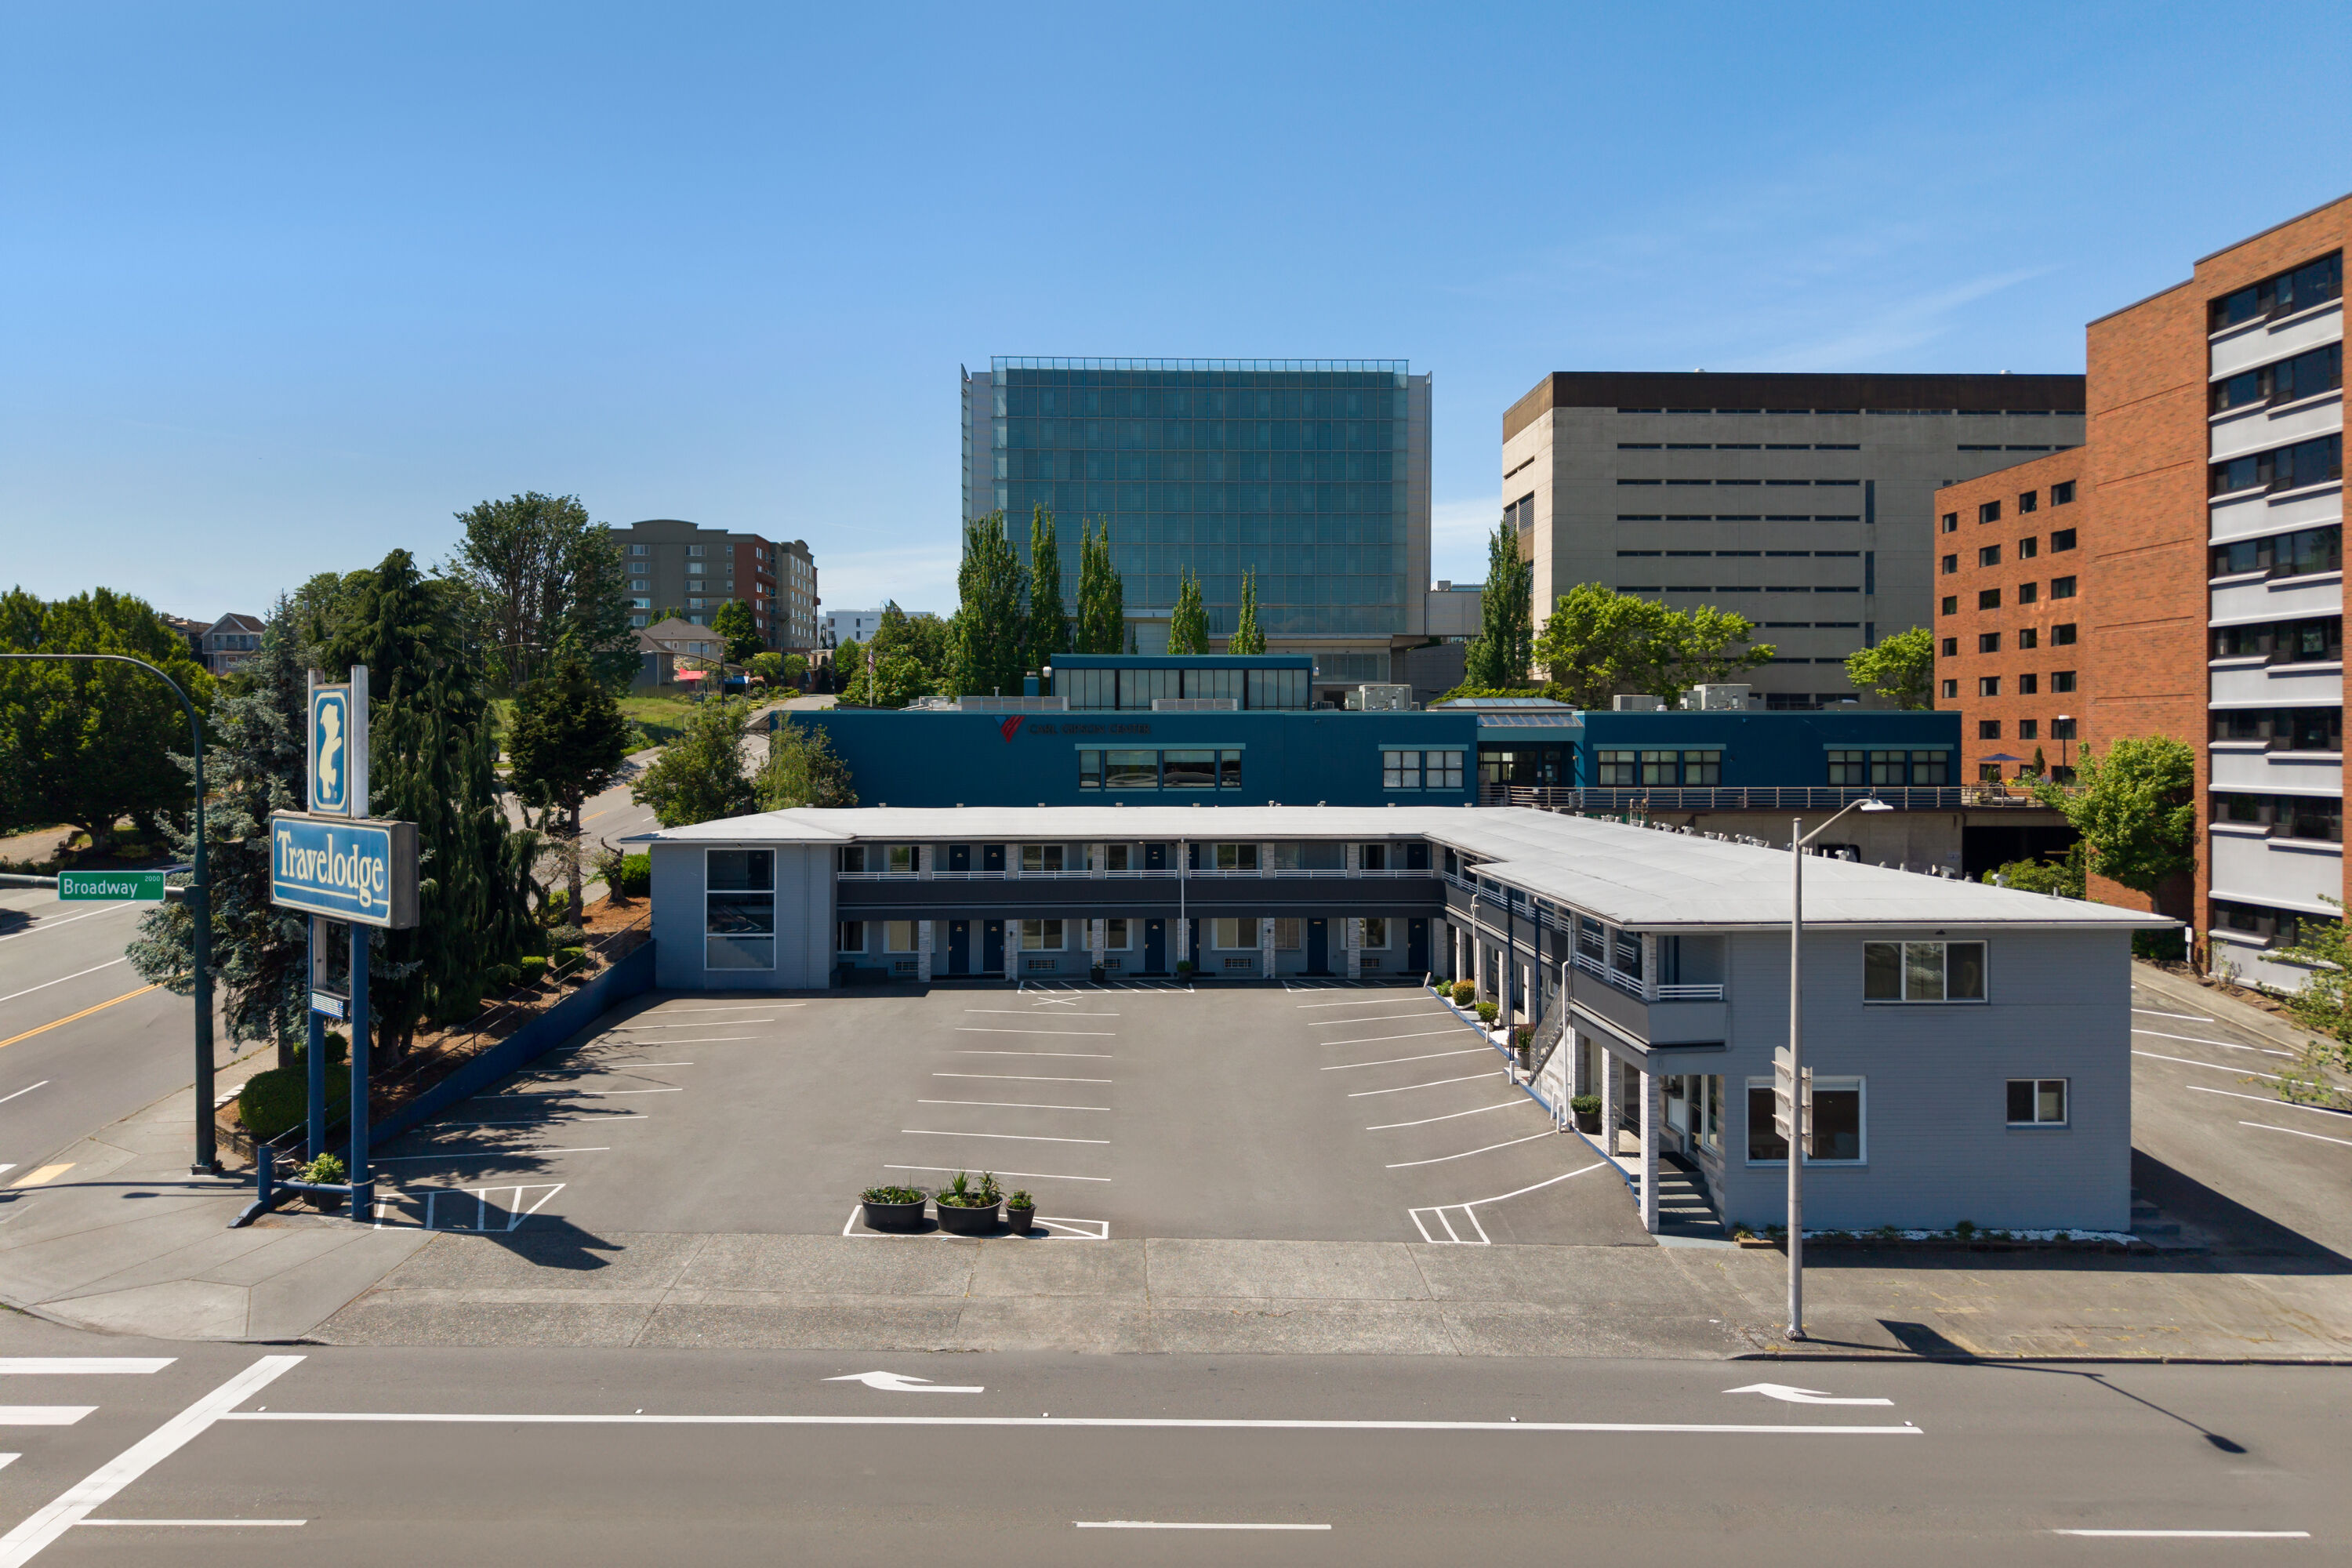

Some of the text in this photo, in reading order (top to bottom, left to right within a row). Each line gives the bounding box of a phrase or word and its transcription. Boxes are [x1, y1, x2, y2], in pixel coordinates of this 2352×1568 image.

[1028, 724, 1151, 735] CARL GIPSON CENTER
[277, 829, 384, 907] Travelodge
[64, 878, 138, 898] Broadway
